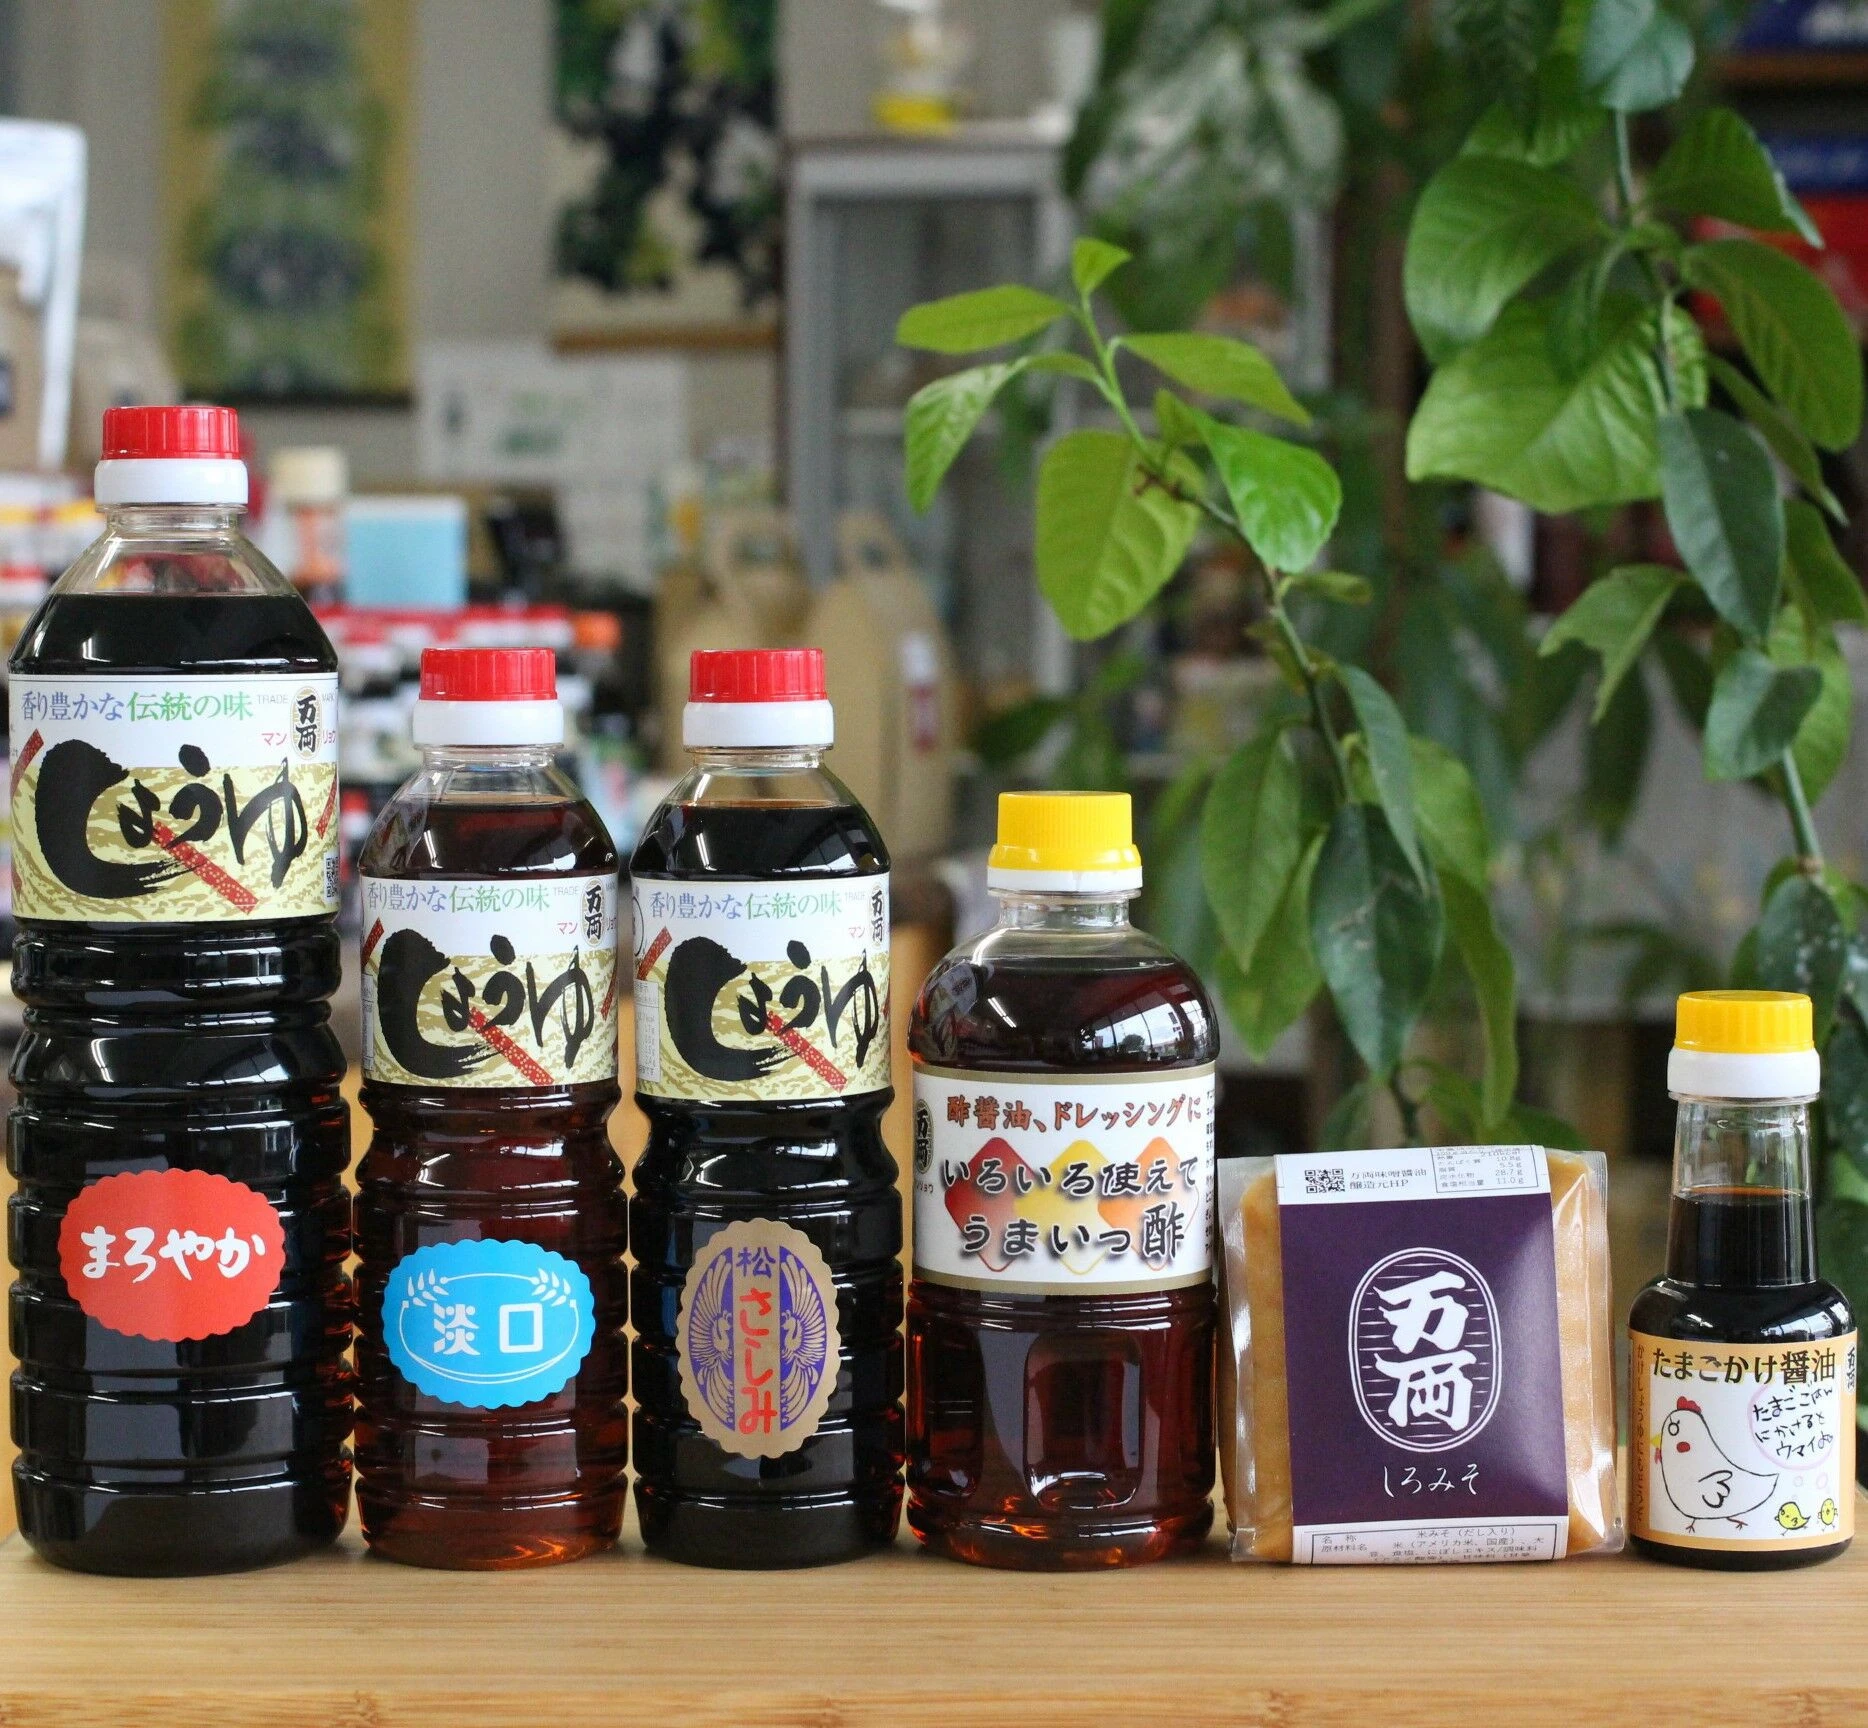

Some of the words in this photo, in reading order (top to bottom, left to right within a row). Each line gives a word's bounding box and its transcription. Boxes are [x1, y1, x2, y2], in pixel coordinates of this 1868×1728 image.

[21, 691, 252, 722] 香り豊かな伝統の味
[257, 694, 288, 705] TRADE
[261, 733, 288, 746] マン
[295, 694, 318, 753] 万両
[35, 739, 308, 899] しょうゆ
[367, 882, 550, 914] 香り豊かな伝統の味
[553, 886, 580, 896] TRADE
[650, 890, 842, 920] 香り豊かな伝統の味
[557, 921, 578, 935] マン
[584, 885, 603, 940] 万両
[848, 926, 865, 939] マン
[377, 928, 594, 1079] しょうゆ
[664, 936, 879, 1082] しょうゆ
[947, 1094, 1202, 1133] 酢醤油、ドレッシングに
[944, 1157, 1199, 1195] いろいろ使えて
[963, 1200, 1185, 1260] うまいっ酢
[81, 1225, 266, 1284] まろやか
[736, 1247, 776, 1278] 松
[433, 1302, 544, 1356] 淡口
[1373, 1271, 1477, 1431] 万両
[1653, 1347, 1836, 1385] たまごかけ醤油
[1382, 1463, 1480, 1497] しろみそ
